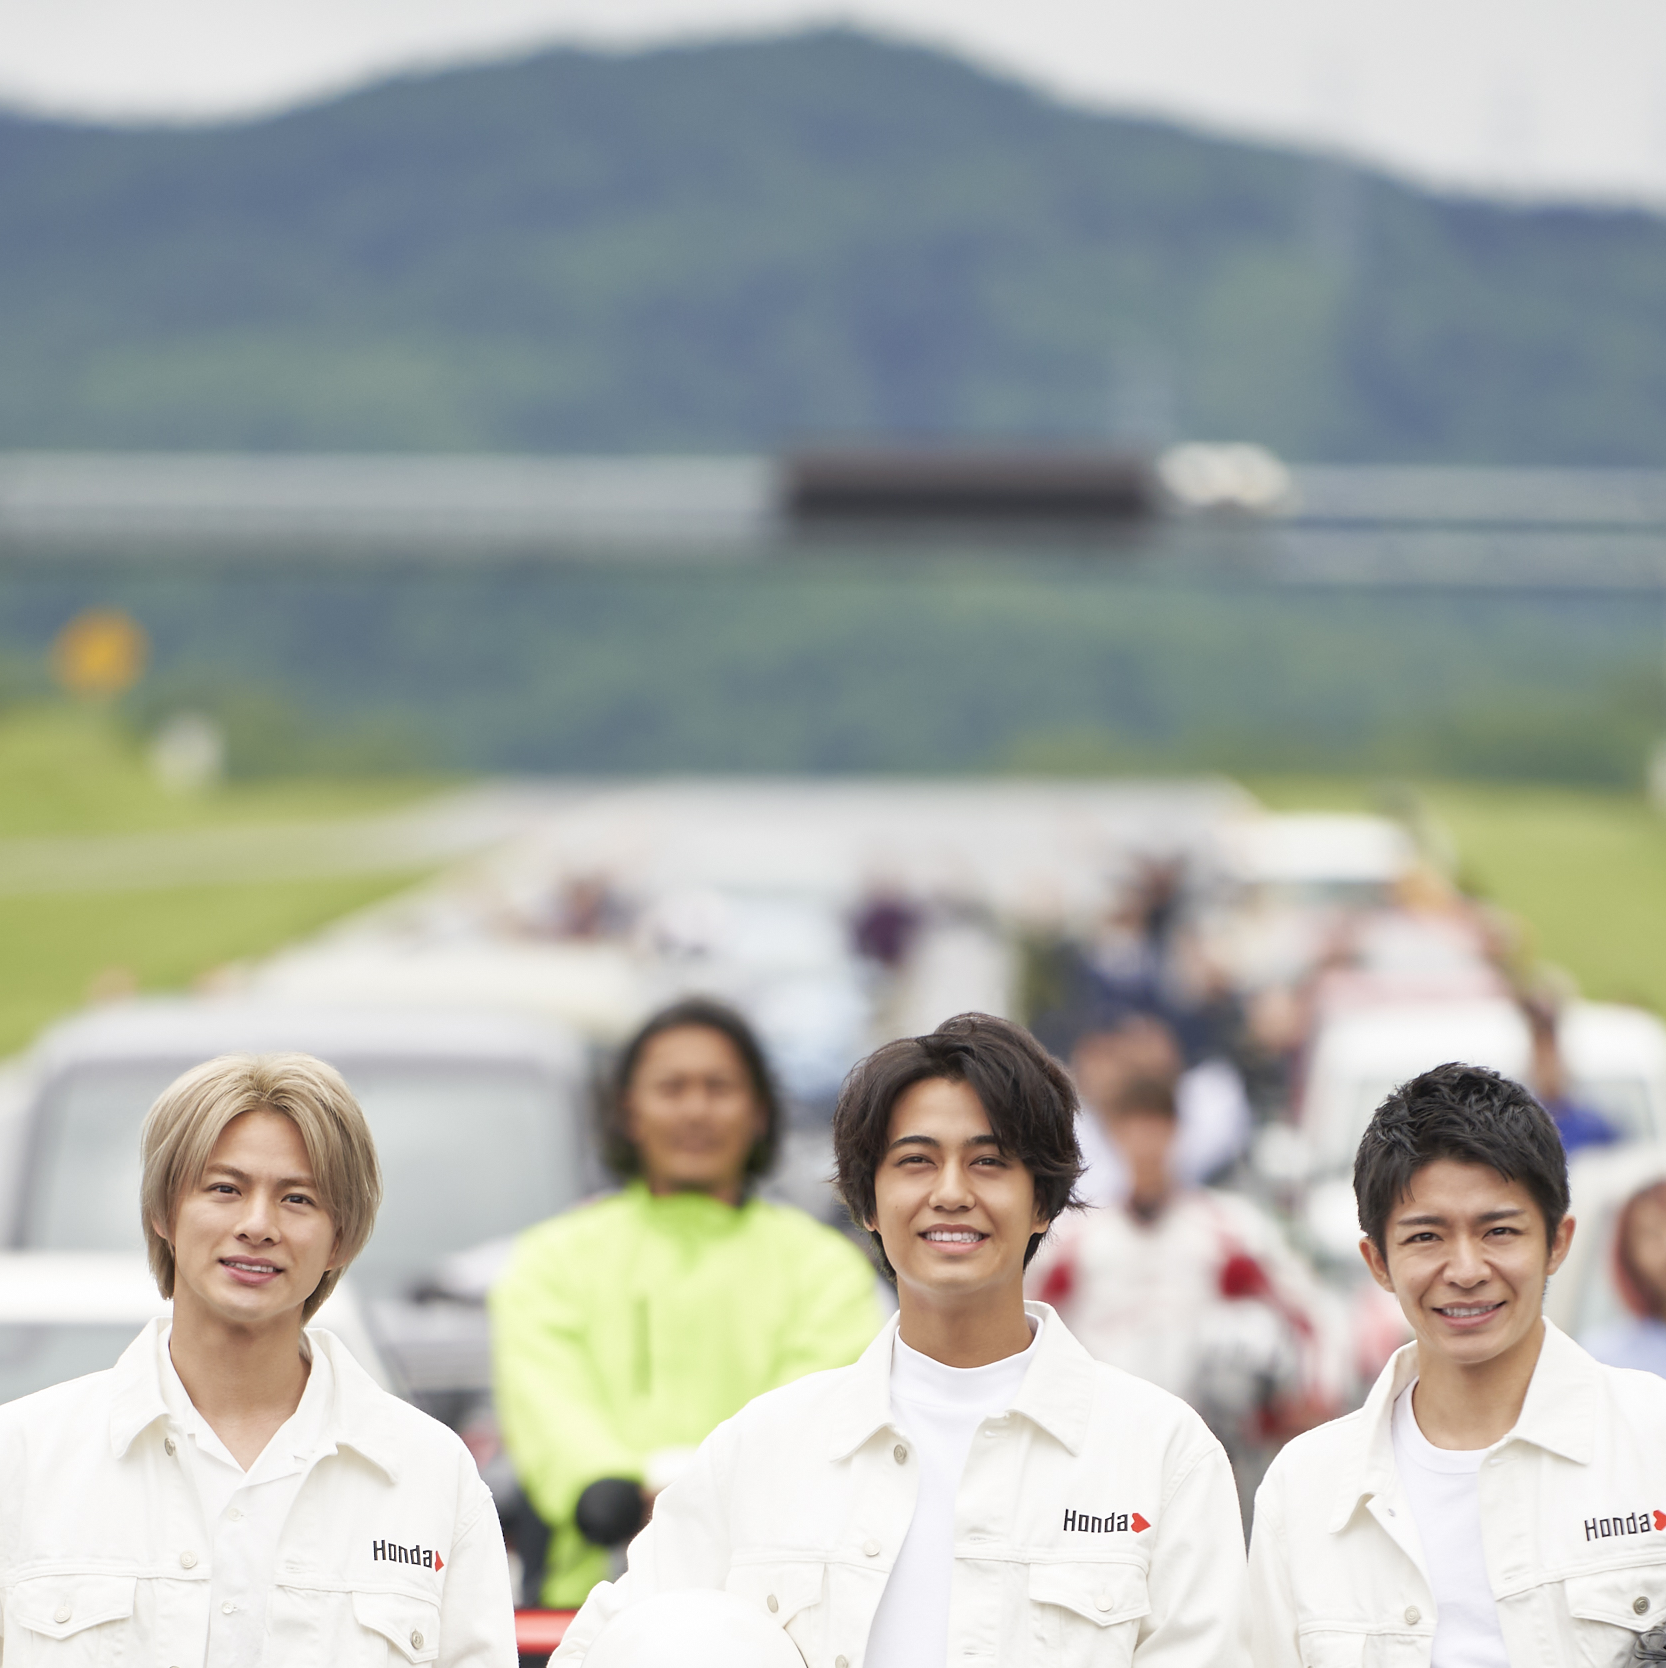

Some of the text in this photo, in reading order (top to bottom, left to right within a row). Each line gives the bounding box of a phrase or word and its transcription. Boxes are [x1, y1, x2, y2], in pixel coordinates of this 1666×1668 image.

[1063, 1508, 1128, 1534] Honda
[1584, 1512, 1652, 1541] Honda
[372, 1539, 433, 1568] Honda
